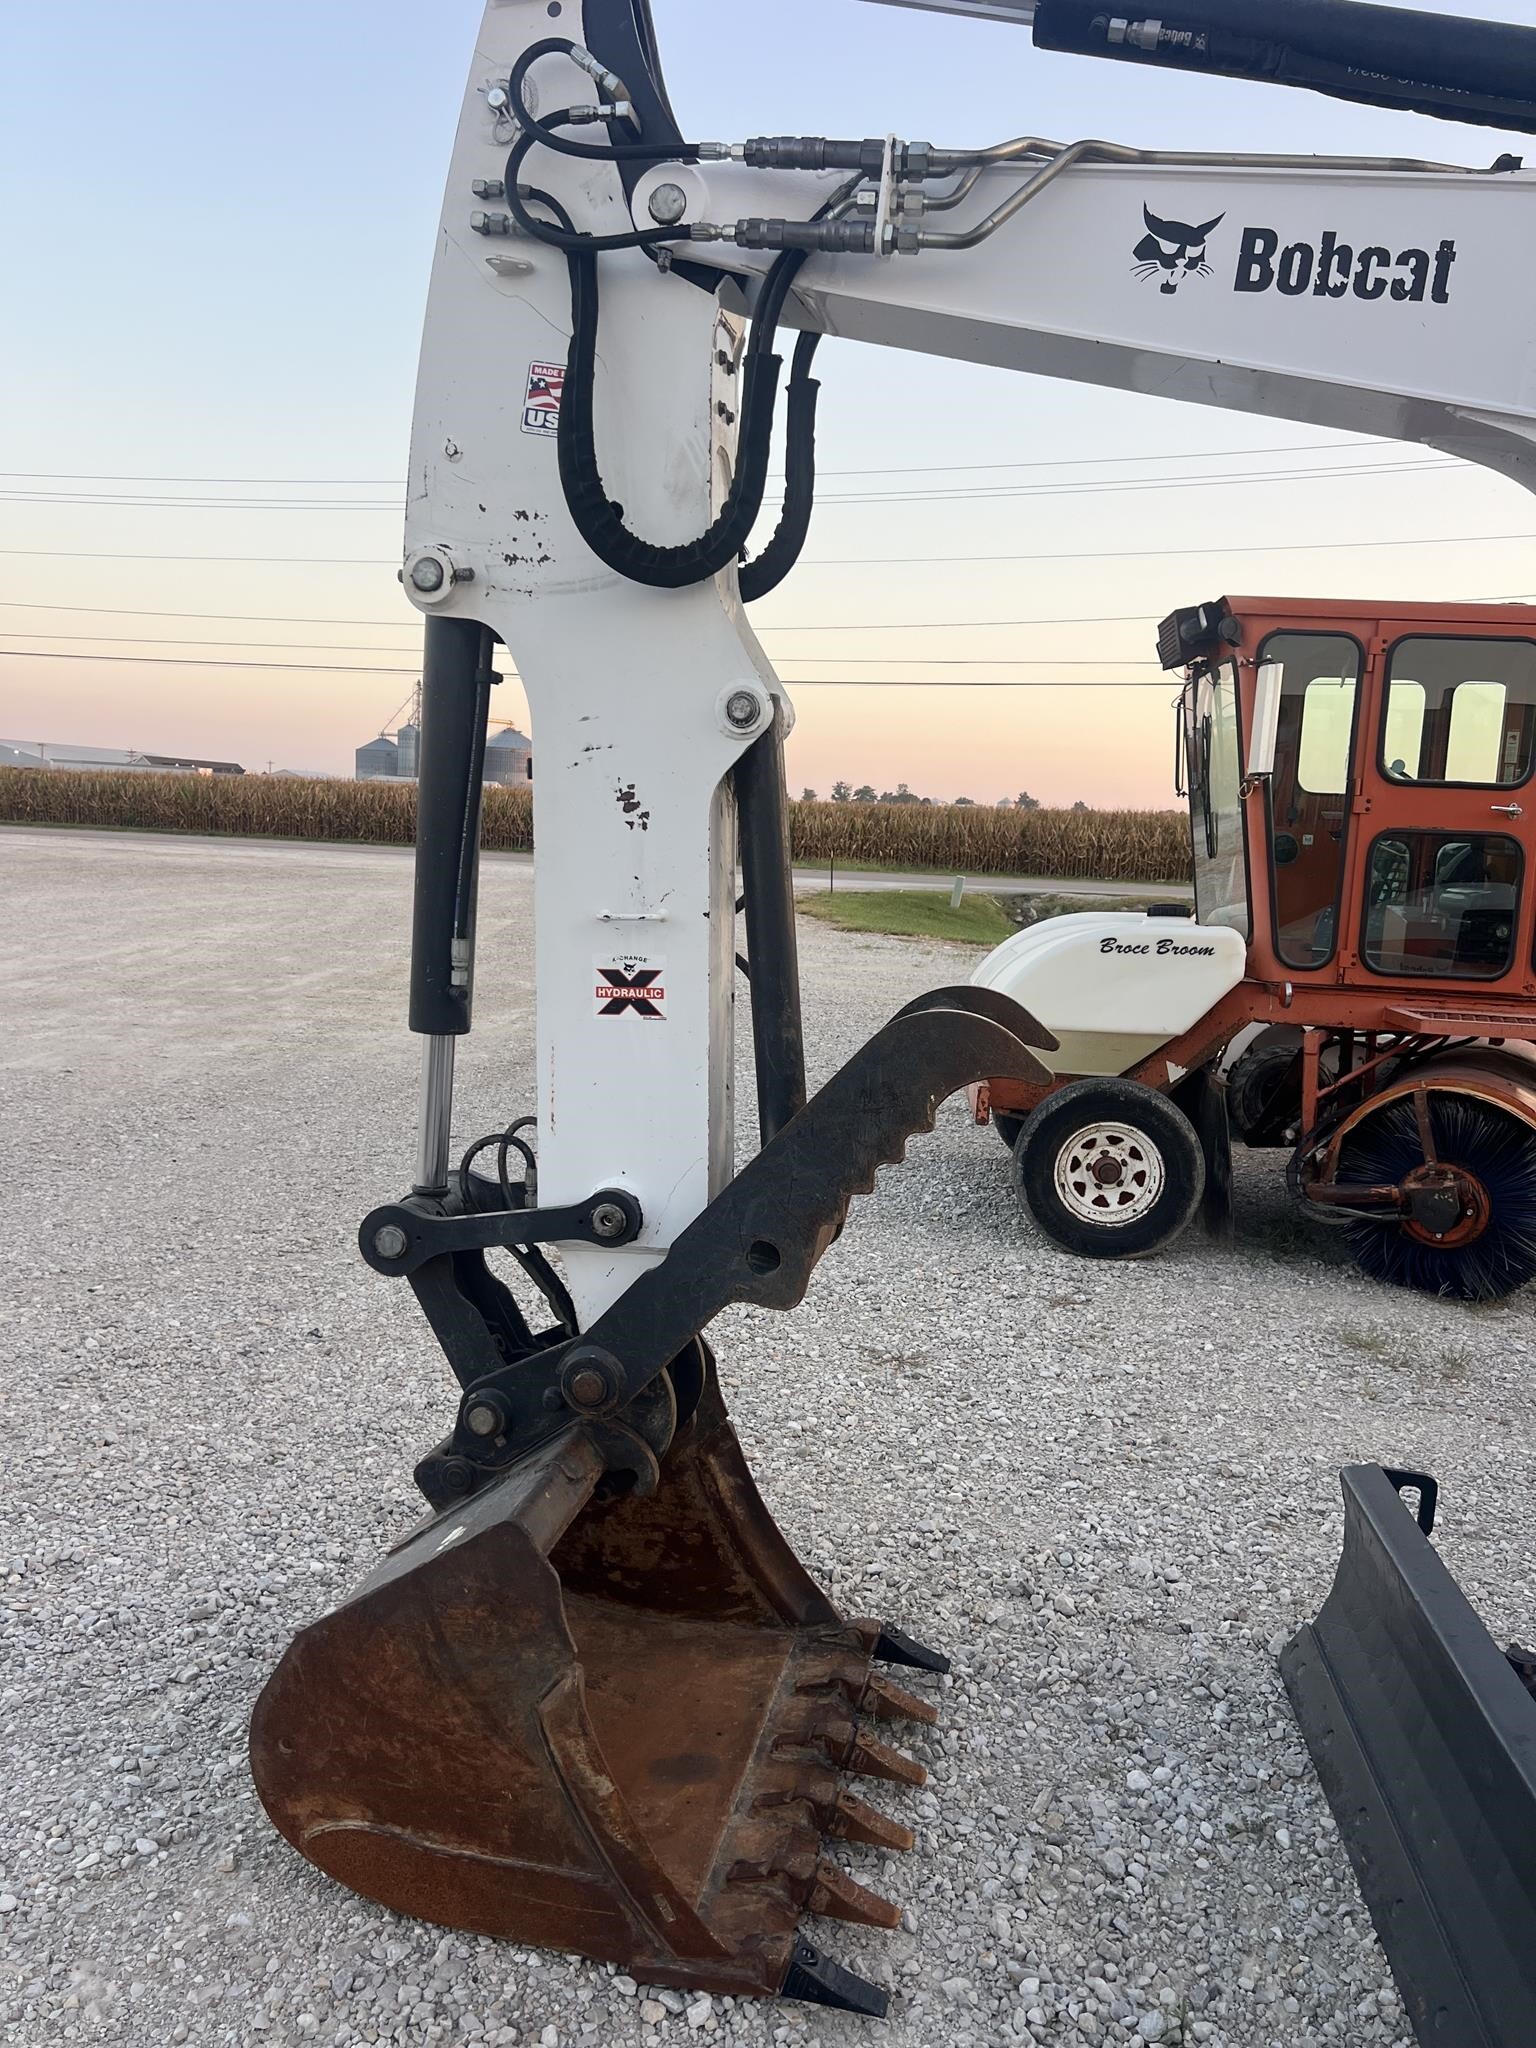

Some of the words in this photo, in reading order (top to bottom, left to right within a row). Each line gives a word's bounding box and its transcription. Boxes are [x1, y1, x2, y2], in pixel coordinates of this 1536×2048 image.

[1159, 28, 1193, 47] Bobca
[1234, 227, 1456, 303] Bobcat
[534, 366, 559, 376] MADE
[527, 409, 559, 429] US
[1100, 937, 1149, 954] Broce
[1156, 939, 1215, 955] Broom
[597, 988, 662, 998] HYDRAULIC
